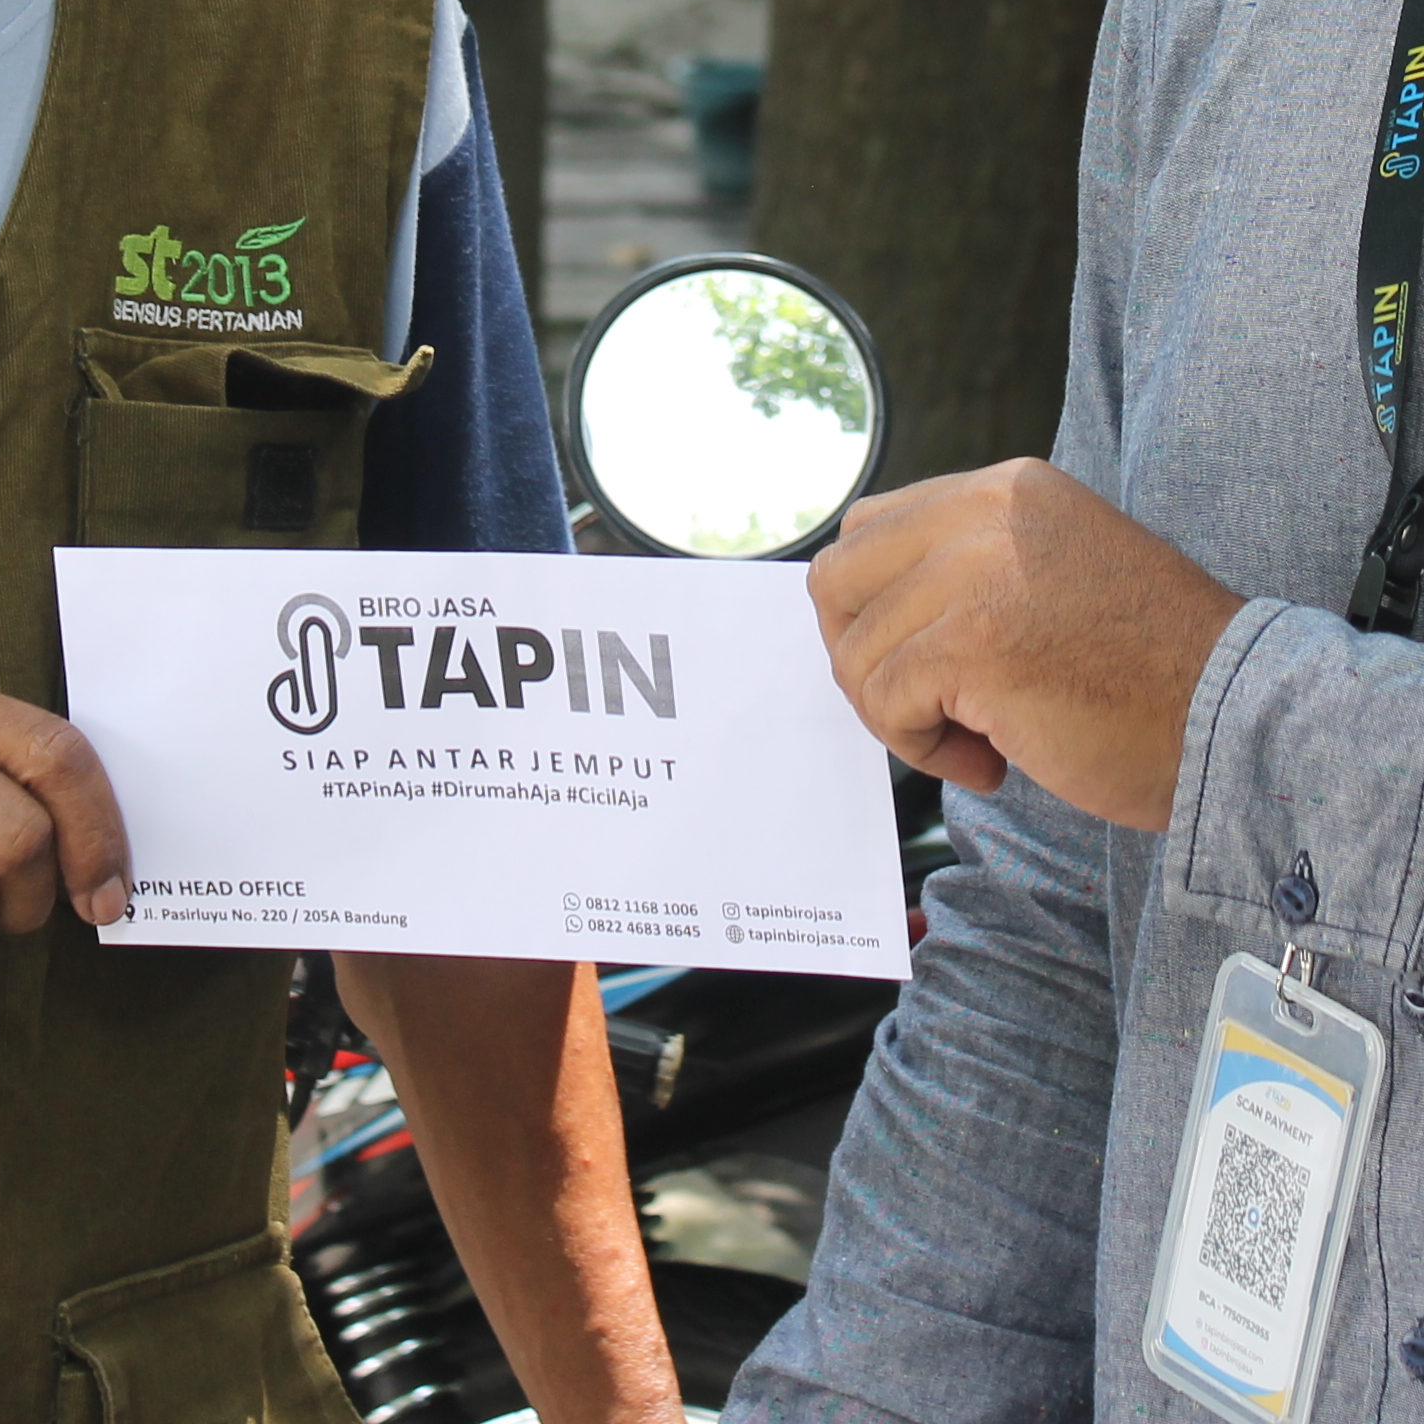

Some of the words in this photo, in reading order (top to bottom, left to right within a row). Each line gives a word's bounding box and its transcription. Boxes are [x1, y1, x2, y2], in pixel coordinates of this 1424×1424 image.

[113, 298, 182, 328] SENSUS
[186, 308, 303, 333] PERTANIAN
[1373, 283, 1399, 403] TAPIN
[359, 597, 421, 618] BIRO
[427, 597, 496, 618] JASA
[359, 626, 677, 719] TAPIN
[282, 748, 369, 771] SIAP
[388, 748, 516, 771] ANTAR
[531, 751, 677, 781] JEMPUT
[322, 781, 426, 801] #TAPinAja
[431, 781, 561, 804] #DirumahAja
[567, 785, 649, 811] #CicilAja
[178, 880, 233, 896] HEAD
[239, 880, 306, 897] OFFICE
[144, 908, 157, 920] Jl.
[162, 908, 228, 923] Pasirluyu
[232, 909, 257, 922] No.
[261, 909, 287, 922] 220
[292, 908, 298, 924] /
[303, 910, 340, 922] 205A
[344, 910, 407, 927] Bandung
[585, 897, 620, 912] 0812
[625, 899, 658, 914] 1168
[663, 902, 698, 917] 1006
[746, 903, 843, 922] tapinbirojasa
[588, 919, 623, 934] 0822
[627, 921, 661, 936] 4683
[665, 923, 701, 938] 8645
[749, 927, 880, 949] tapinbirojasa.com
[1236, 1094, 1263, 1119] SCAN
[1264, 1110, 1313, 1147] PAYMENT
[1198, 1289, 1216, 1309] BCA
